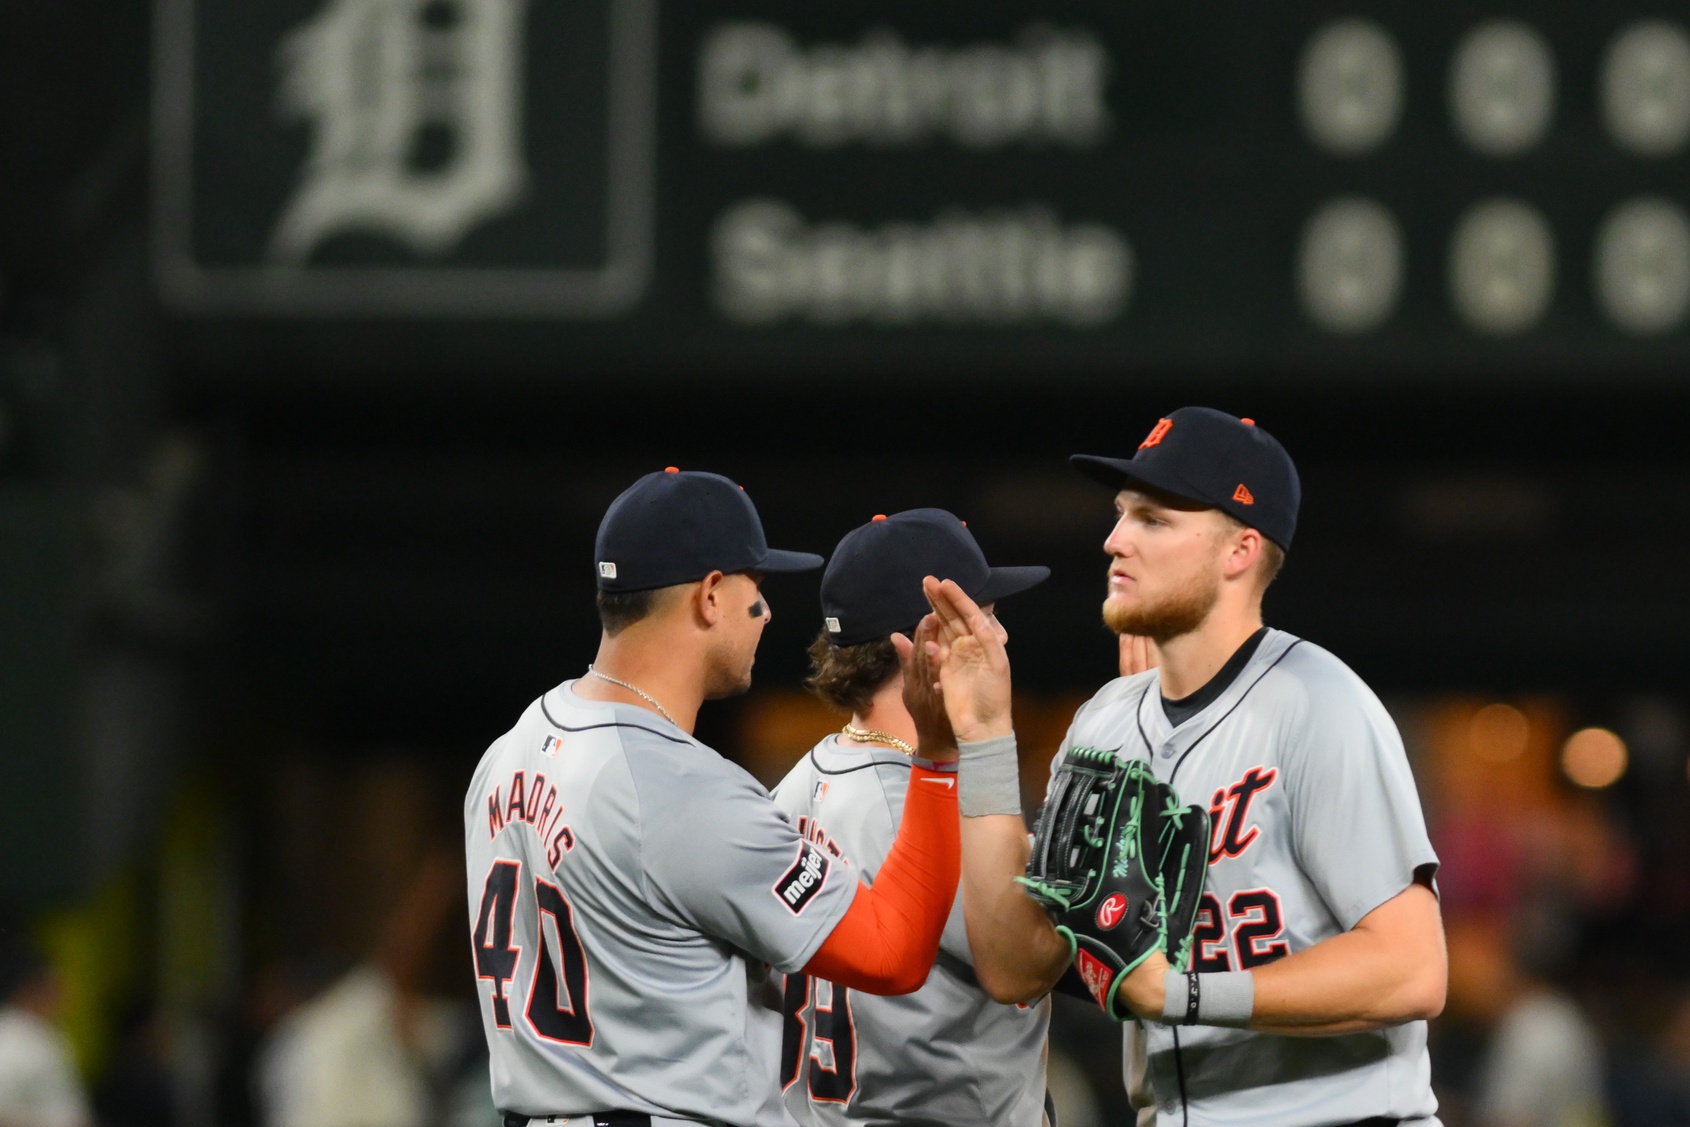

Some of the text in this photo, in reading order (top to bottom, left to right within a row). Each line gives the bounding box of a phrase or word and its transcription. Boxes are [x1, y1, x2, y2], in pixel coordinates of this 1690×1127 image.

[700, 24, 1107, 145] Detroit
[1301, 23, 1401, 151] 0
[1453, 24, 1553, 151] 0
[713, 201, 1133, 324] Seattle
[1301, 202, 1401, 330] 0
[1452, 202, 1553, 332] 0
[487, 770, 576, 874] MADRIS
[472, 858, 596, 1049] 40
[1190, 887, 1291, 973] 22
